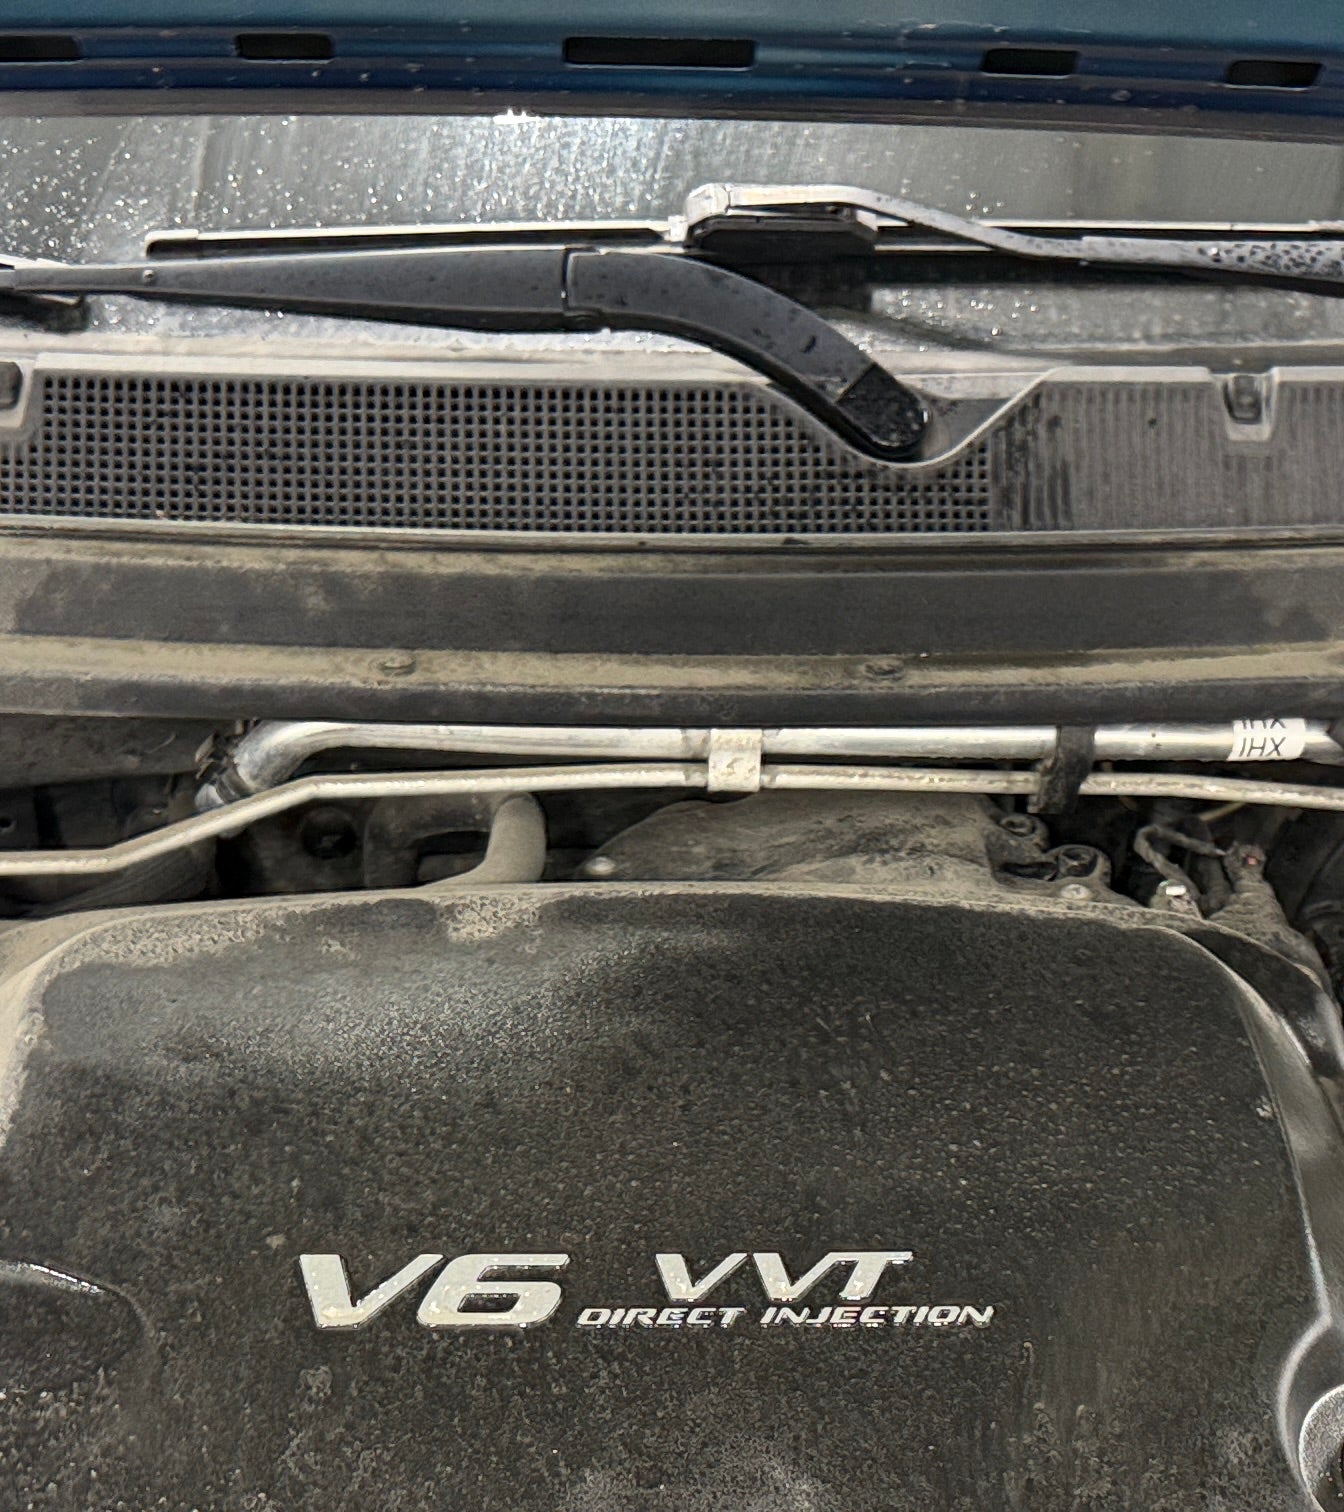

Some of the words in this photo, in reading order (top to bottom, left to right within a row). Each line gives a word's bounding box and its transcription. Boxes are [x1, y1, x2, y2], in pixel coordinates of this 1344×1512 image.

[299, 1253, 570, 1328] V6
[656, 1251, 914, 1301] VVT
[577, 1306, 747, 1328] DIRECT
[759, 1305, 996, 1328] INJECTION
